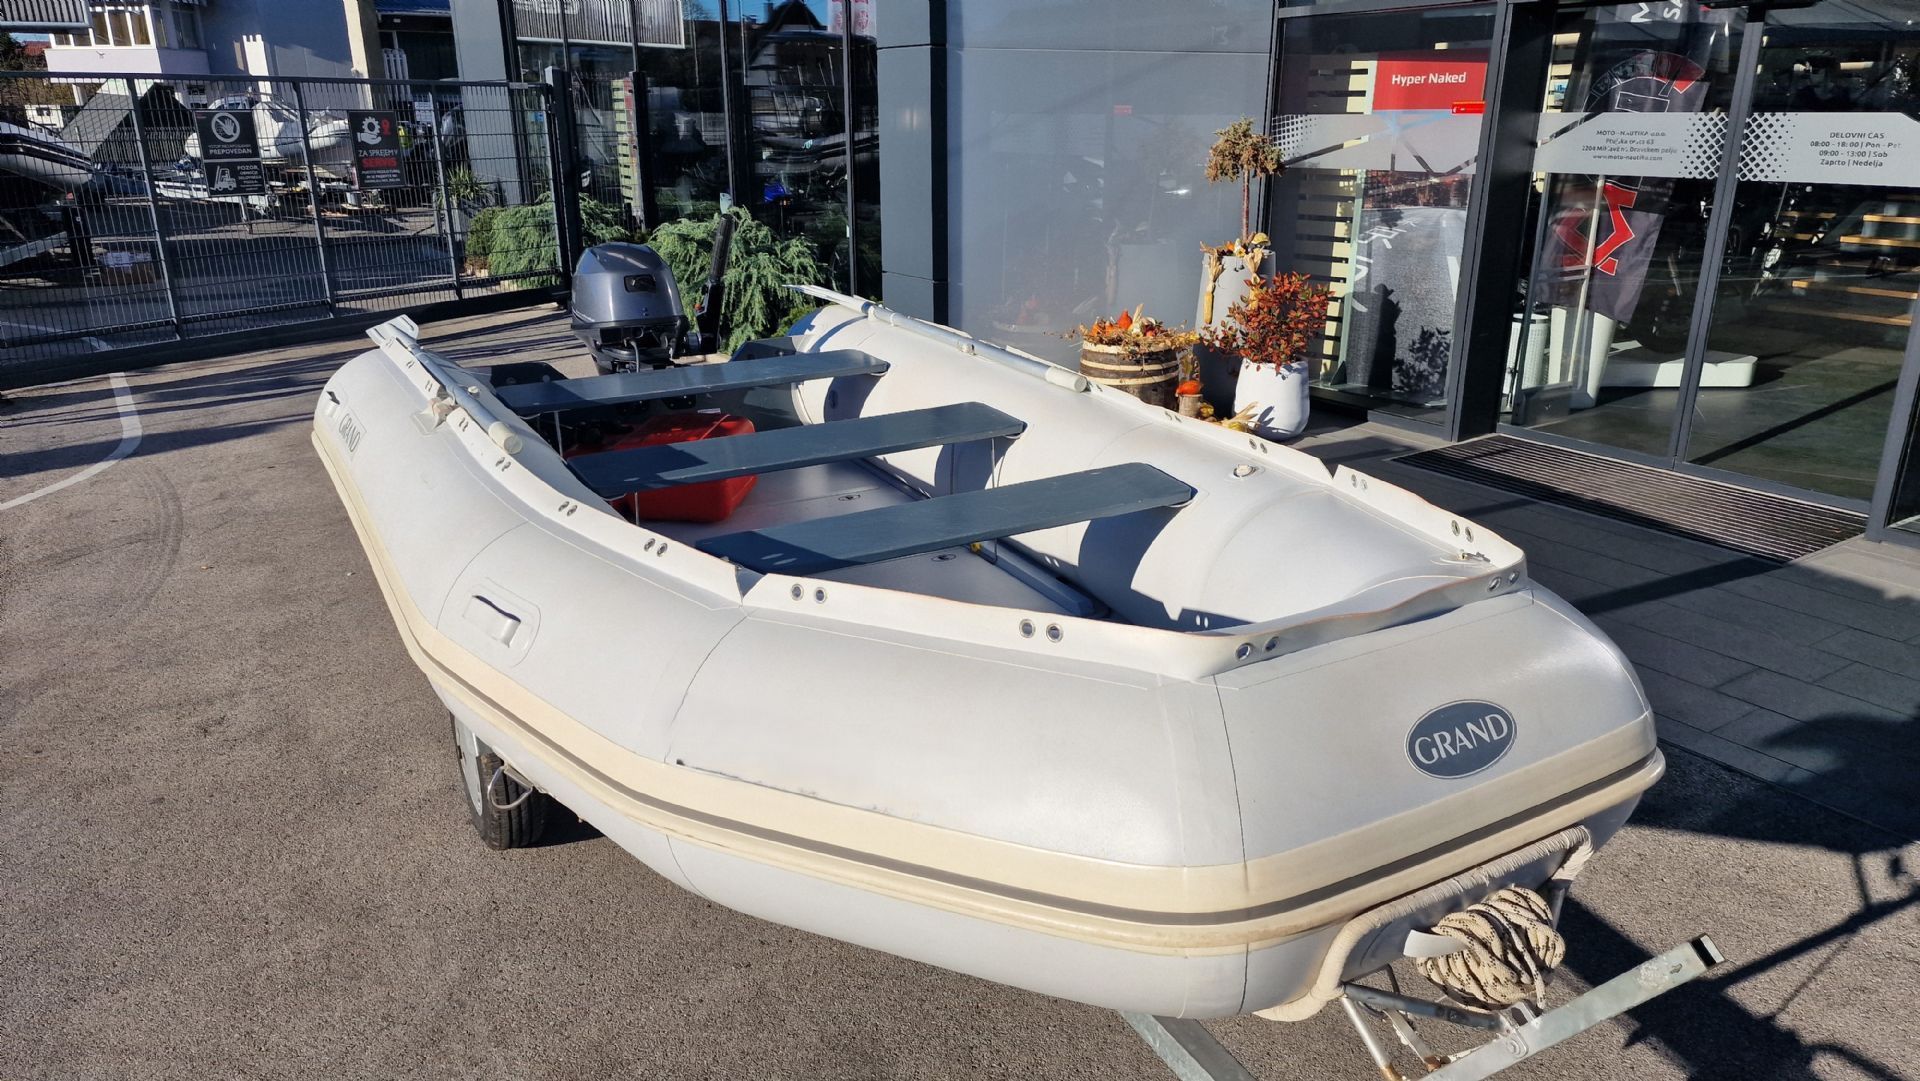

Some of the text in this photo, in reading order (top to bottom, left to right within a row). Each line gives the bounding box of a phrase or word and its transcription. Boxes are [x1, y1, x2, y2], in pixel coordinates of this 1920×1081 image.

[1391, 71, 1467, 87] Hyper Naked
[358, 149, 368, 157] ZA
[368, 149, 394, 158] SPREJEM
[1846, 150, 1867, 158] 13:00
[362, 157, 397, 168] SERVIS
[1820, 159, 1846, 167] Zaprto
[1852, 159, 1883, 168] Nedelja
[1414, 713, 1508, 765] GRAND
